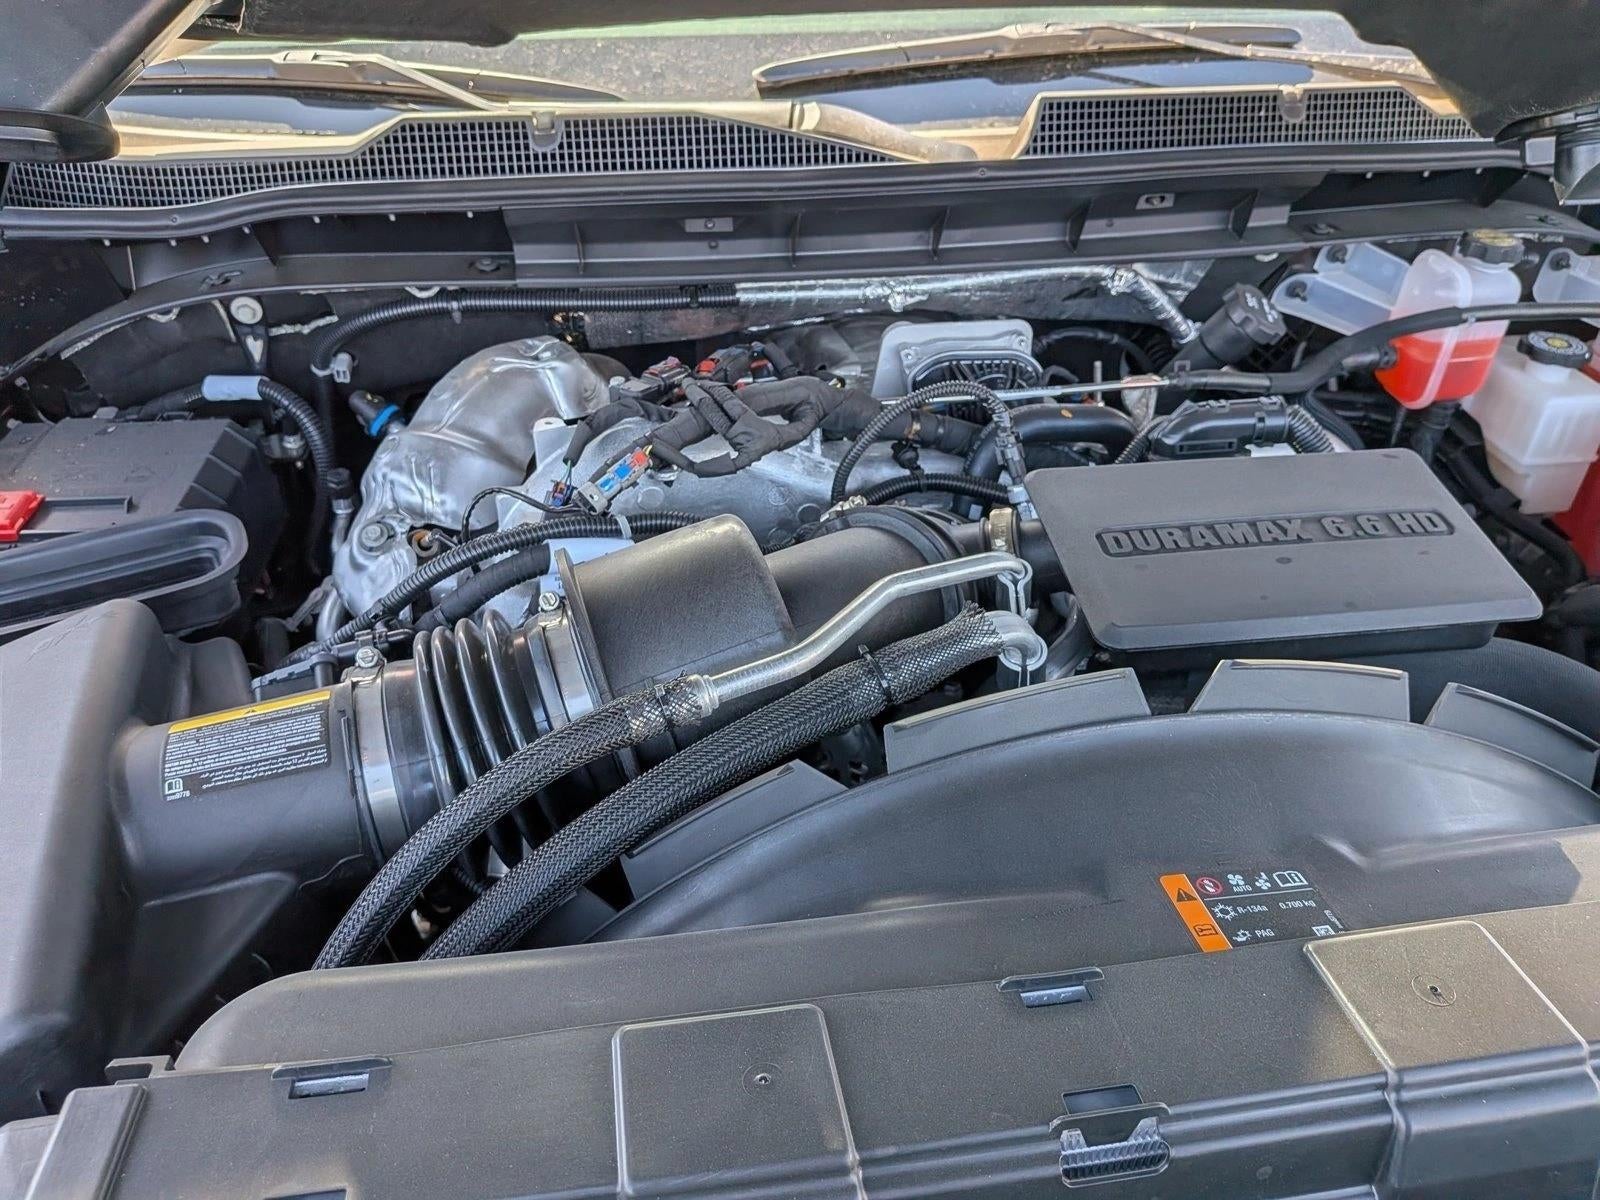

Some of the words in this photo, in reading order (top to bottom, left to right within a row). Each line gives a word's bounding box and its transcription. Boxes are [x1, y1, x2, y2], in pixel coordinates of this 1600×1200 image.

[1101, 518, 1312, 554] DURAMAX
[1320, 514, 1385, 539] 6.6
[1388, 511, 1448, 534] HD
[1233, 884, 1253, 893] AUTO
[1237, 904, 1269, 915] R-134a
[1279, 900, 1302, 910] 0.700
[1302, 899, 1317, 908] kg
[1255, 928, 1275, 938] PAG
